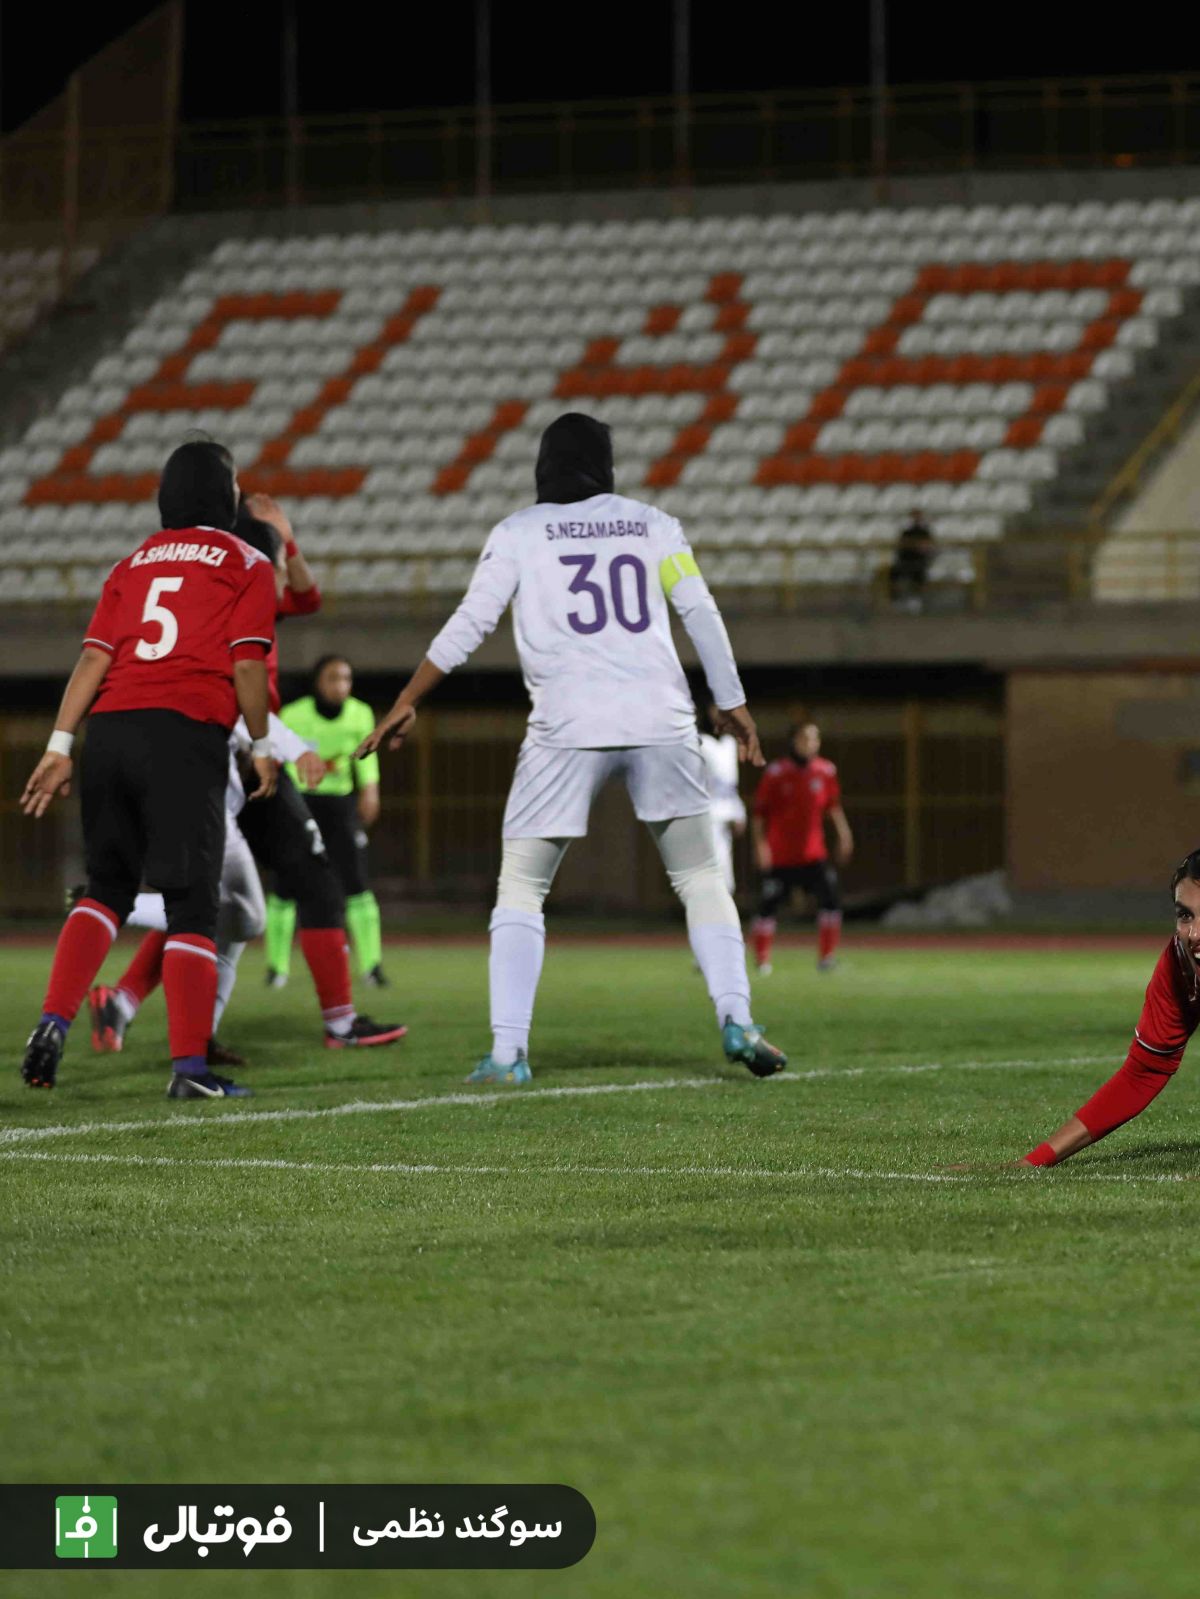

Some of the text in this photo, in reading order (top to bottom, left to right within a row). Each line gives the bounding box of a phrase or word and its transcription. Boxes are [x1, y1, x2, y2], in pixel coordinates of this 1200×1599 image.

[129, 542, 229, 569] R.SHAHBAZI
[545, 519, 649, 541] S.NEZAMABADI
[134, 576, 184, 661] 5
[558, 553, 651, 635] 30
